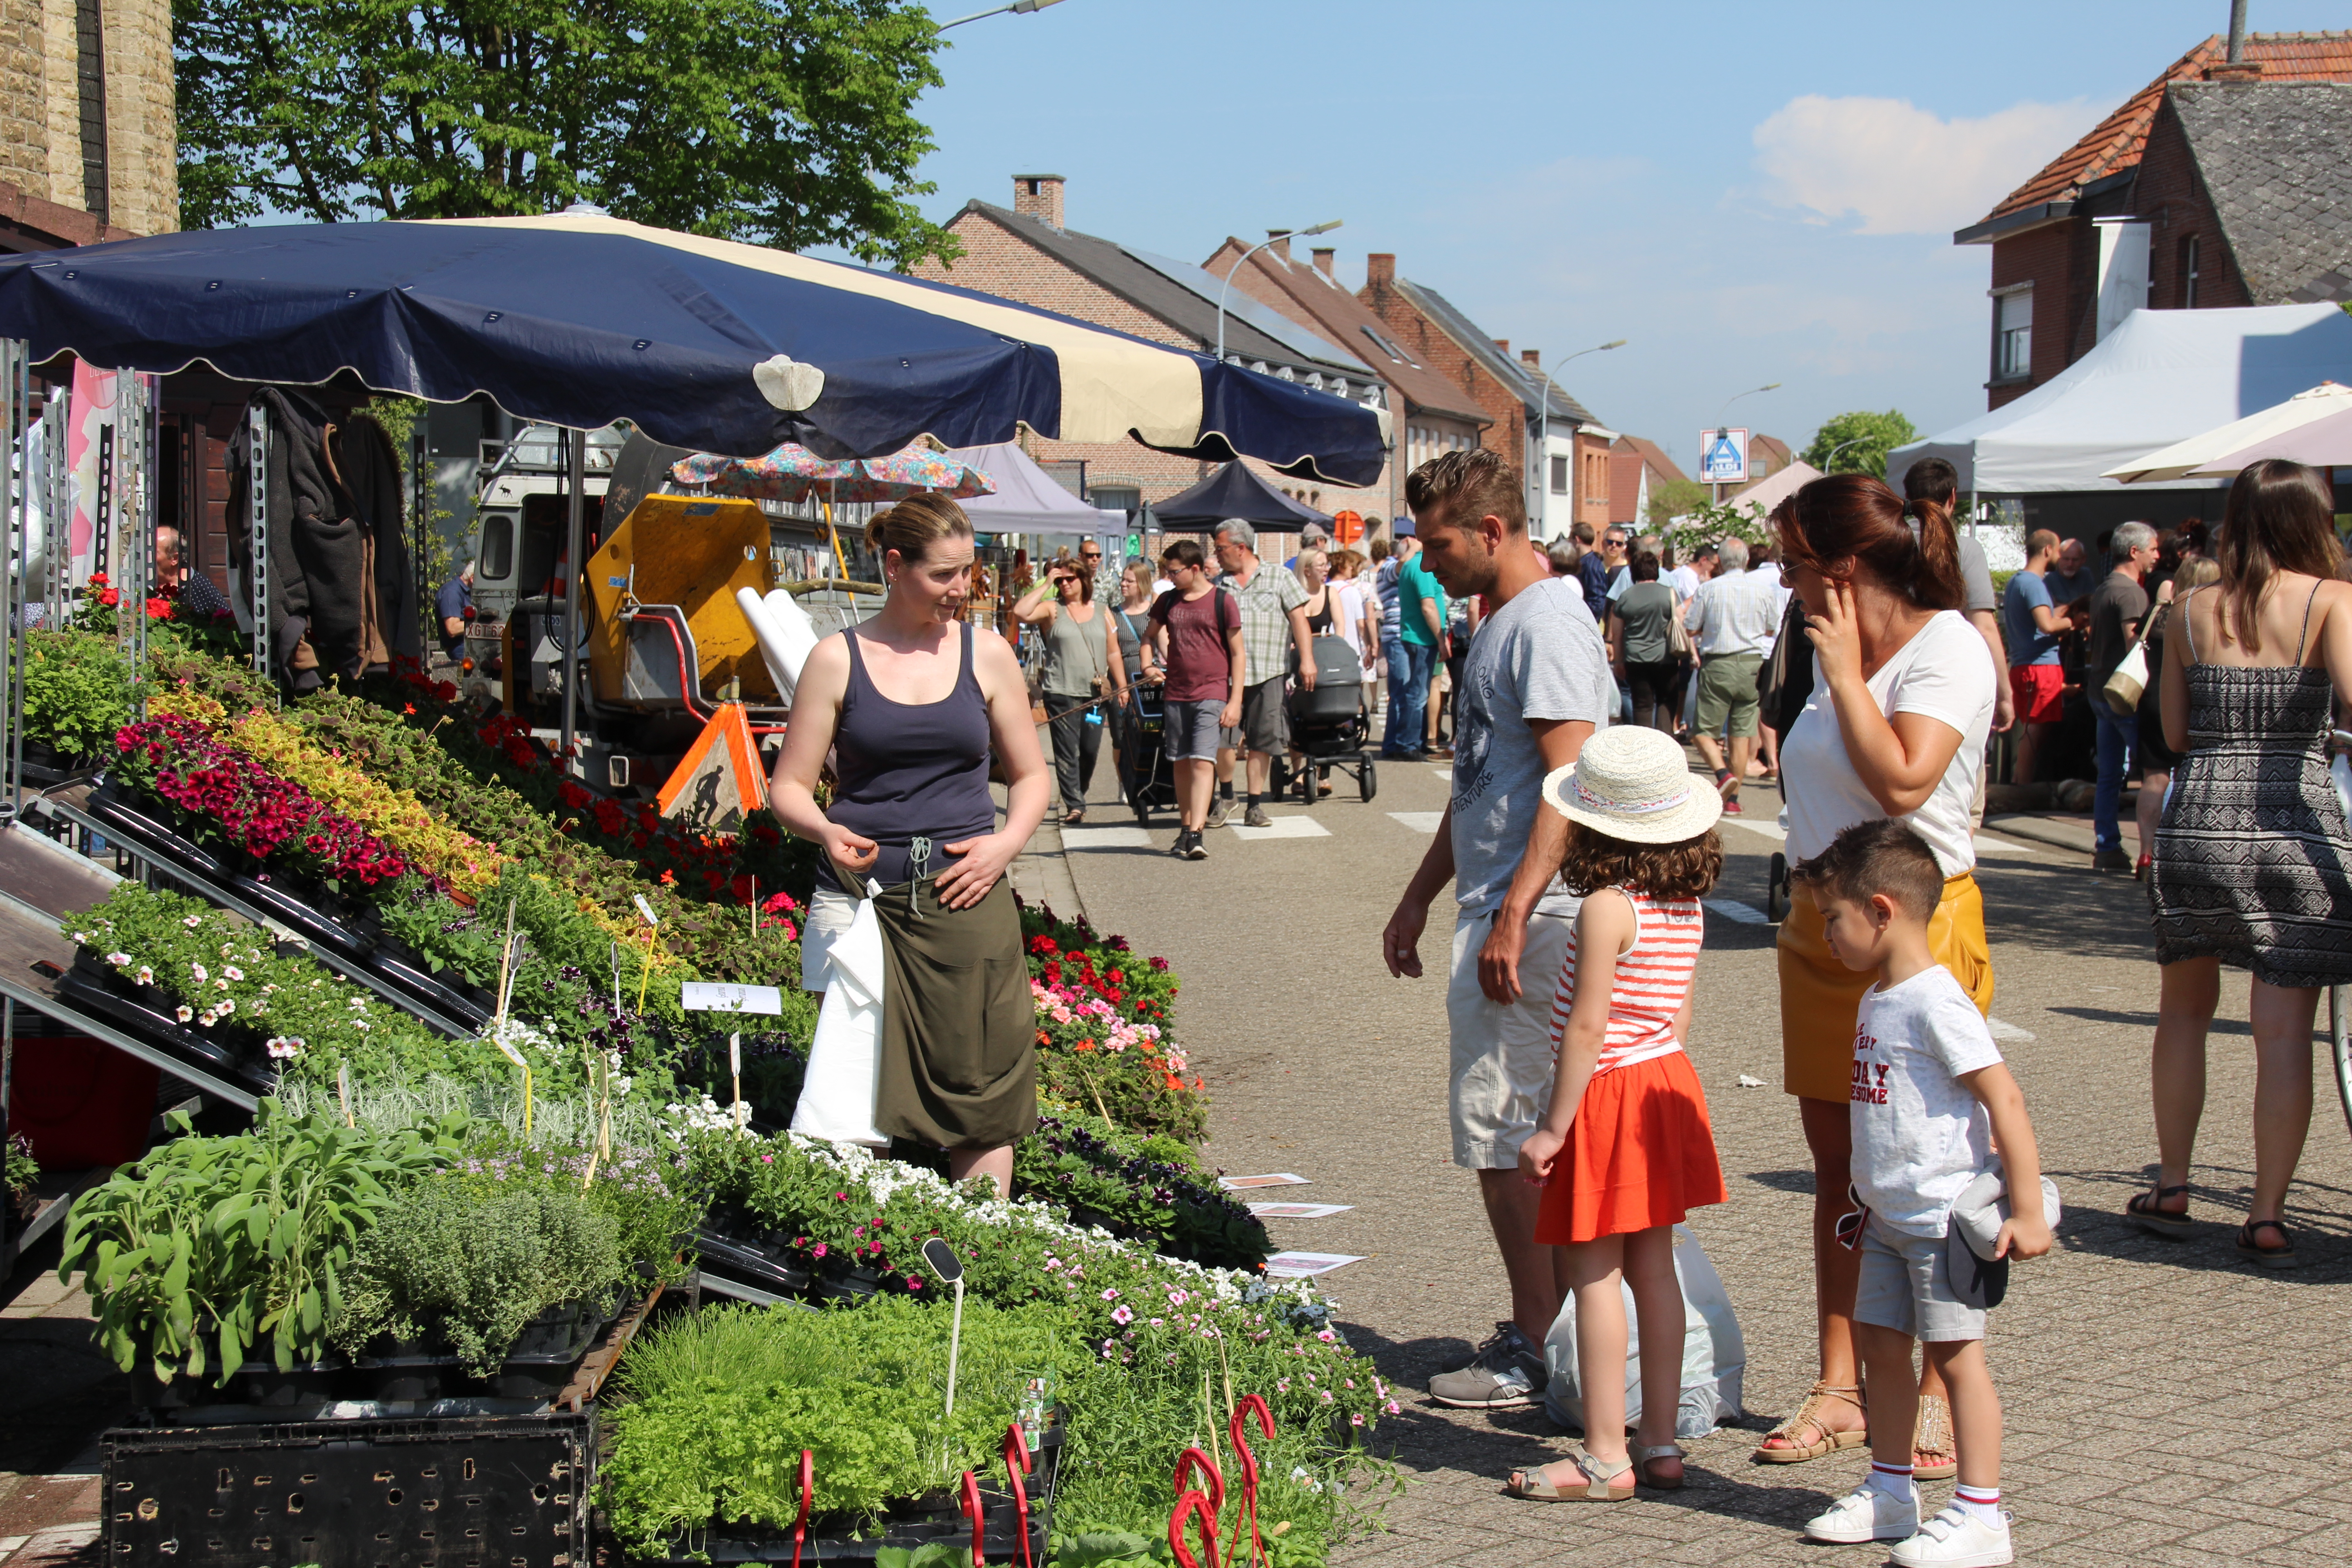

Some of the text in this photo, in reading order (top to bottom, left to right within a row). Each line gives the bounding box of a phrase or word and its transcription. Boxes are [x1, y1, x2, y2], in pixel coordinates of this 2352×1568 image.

[1710, 463, 1738, 471] ALDI
[468, 624, 505, 637] XGT-62
[1452, 769, 1494, 815] DVENTURE
[1854, 1036, 1877, 1052] VERY
[1852, 1060, 1890, 1086] DAY
[1850, 1084, 1888, 1105] ESOME
[1988, 1555, 2009, 1563] adidas
